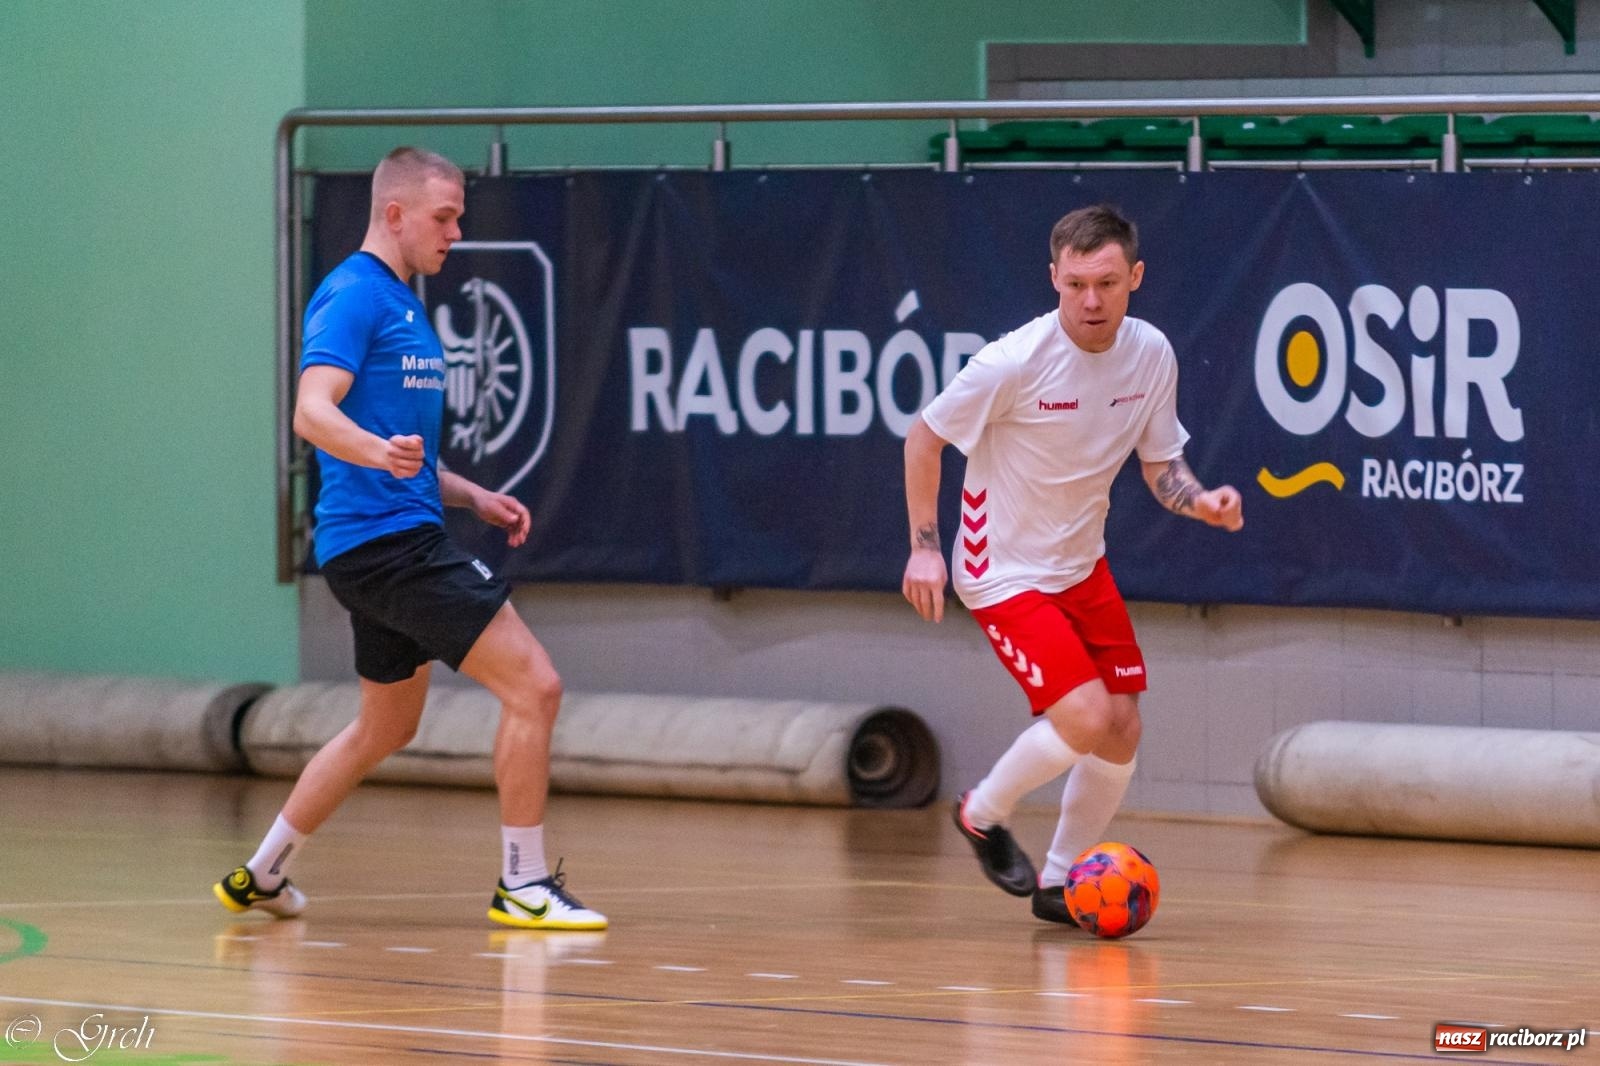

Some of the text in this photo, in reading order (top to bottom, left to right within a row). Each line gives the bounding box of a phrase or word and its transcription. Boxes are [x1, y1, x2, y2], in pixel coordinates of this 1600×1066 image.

[628, 289, 1008, 438] RACIBÓ
[1039, 398, 1079, 411] hummel
[1361, 448, 1524, 503] RACIBÓRZ
